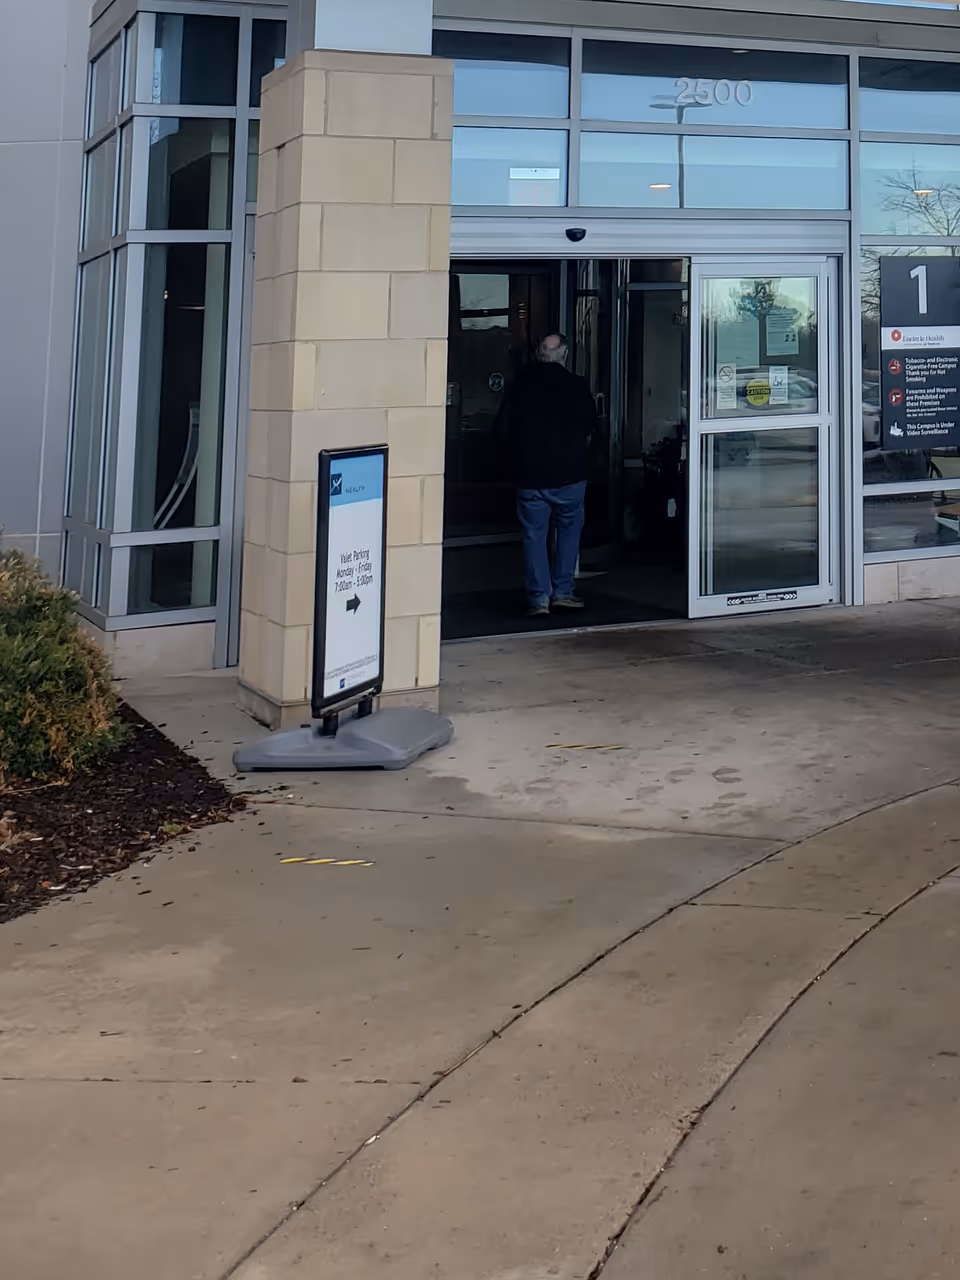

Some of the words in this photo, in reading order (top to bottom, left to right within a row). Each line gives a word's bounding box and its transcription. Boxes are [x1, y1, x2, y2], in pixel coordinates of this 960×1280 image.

[674, 77, 752, 106] 2500
[910, 265, 927, 314] 1
[340, 551, 352, 564] Valet
[353, 549, 369, 561] Parking
[336, 566, 354, 579] Monday
[358, 561, 372, 573] Friday
[335, 580, 352, 593] 7:00am
[357, 574, 373, 587] 5:00pm
